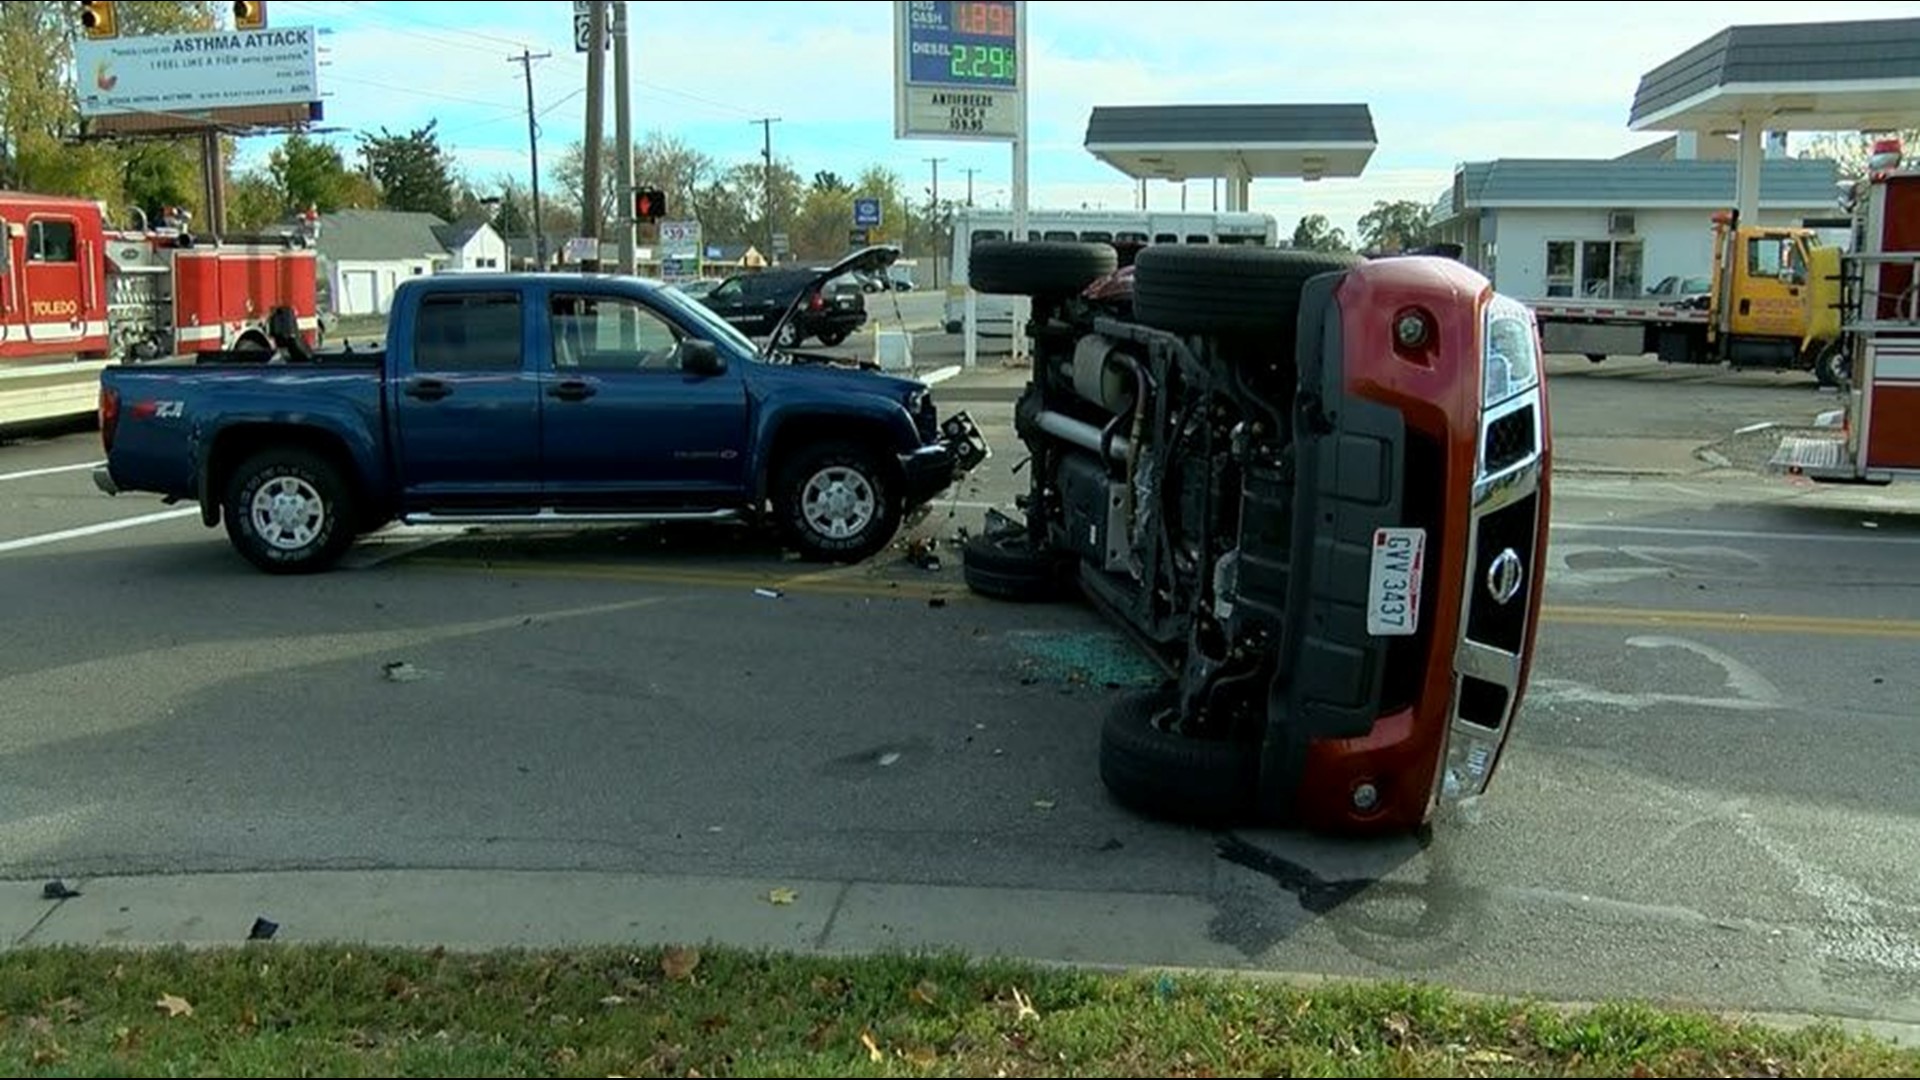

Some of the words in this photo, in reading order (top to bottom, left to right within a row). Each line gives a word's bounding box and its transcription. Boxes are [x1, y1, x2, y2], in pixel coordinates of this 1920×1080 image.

[912, 12, 942, 24] CASH
[172, 35, 241, 53] ASTHMA
[244, 30, 308, 48] ATTACK
[912, 42, 951, 56] DIESEL
[952, 45, 1004, 78] 2.29
[932, 94, 993, 107] ANTIFREEZE
[32, 300, 77, 316] TOLEDO
[1380, 579, 1407, 627] 3437
